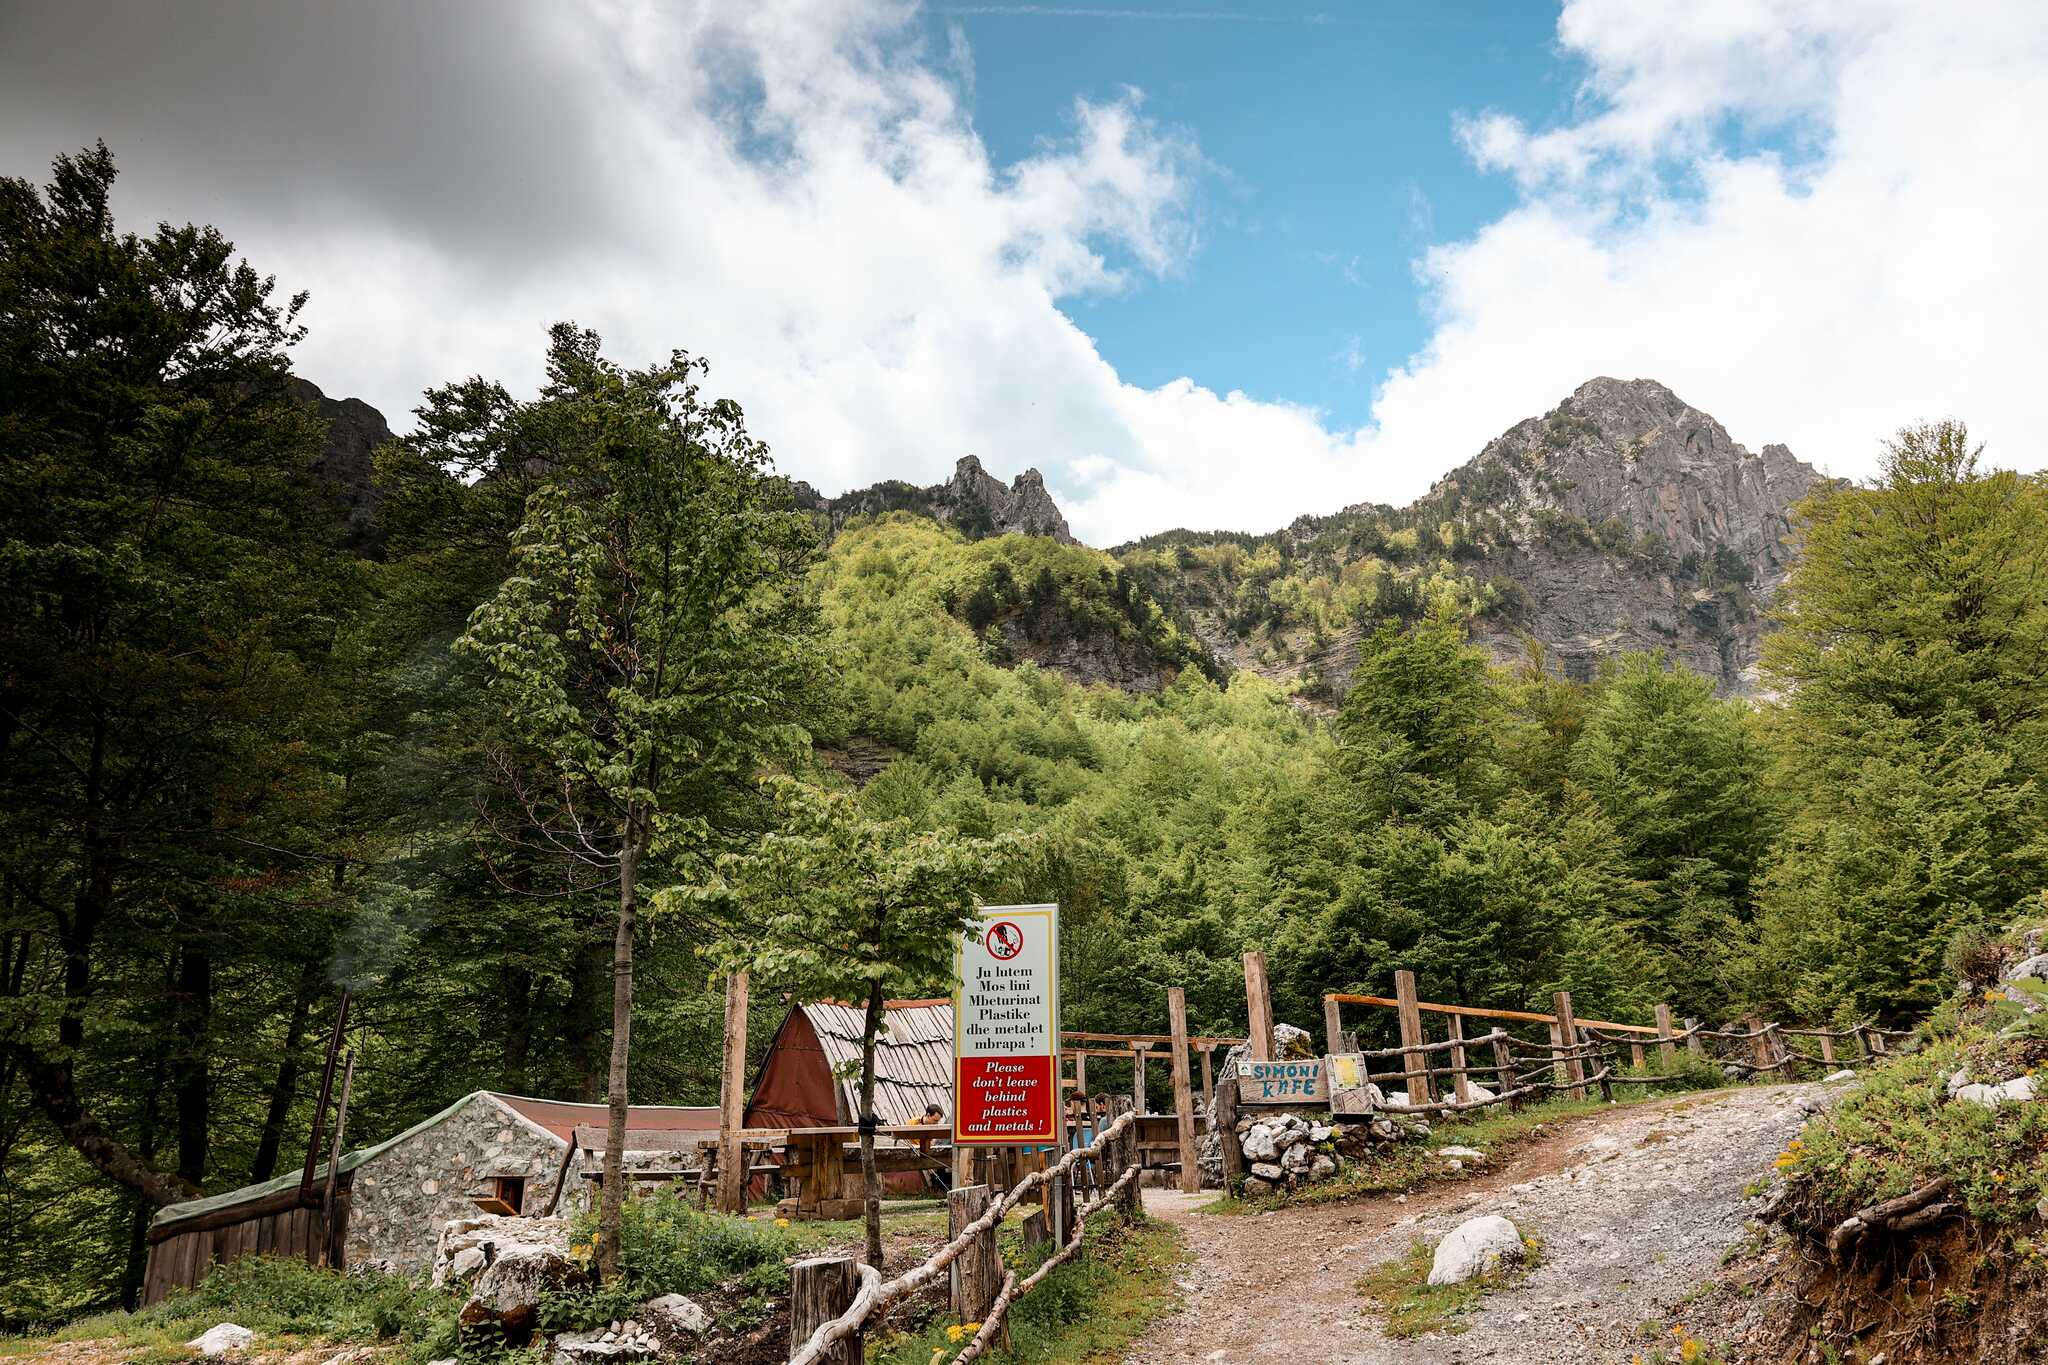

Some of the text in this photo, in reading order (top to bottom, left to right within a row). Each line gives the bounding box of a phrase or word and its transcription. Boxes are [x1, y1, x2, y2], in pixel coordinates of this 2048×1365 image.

[976, 966, 1032, 979] Ju lutem
[980, 980, 1030, 991] Mos lini
[969, 995, 1040, 1006] Mbeturinat
[980, 1008, 1030, 1020] Plastike
[967, 1022, 1043, 1035] dhe metalet
[975, 1037, 1034, 1051] mbrapa !
[986, 1062, 1024, 1073] Please
[973, 1076, 1038, 1087] don't leave
[985, 1091, 1025, 1102] behind
[983, 1106, 1027, 1119] plastics
[968, 1119, 1043, 1132] and metals !
